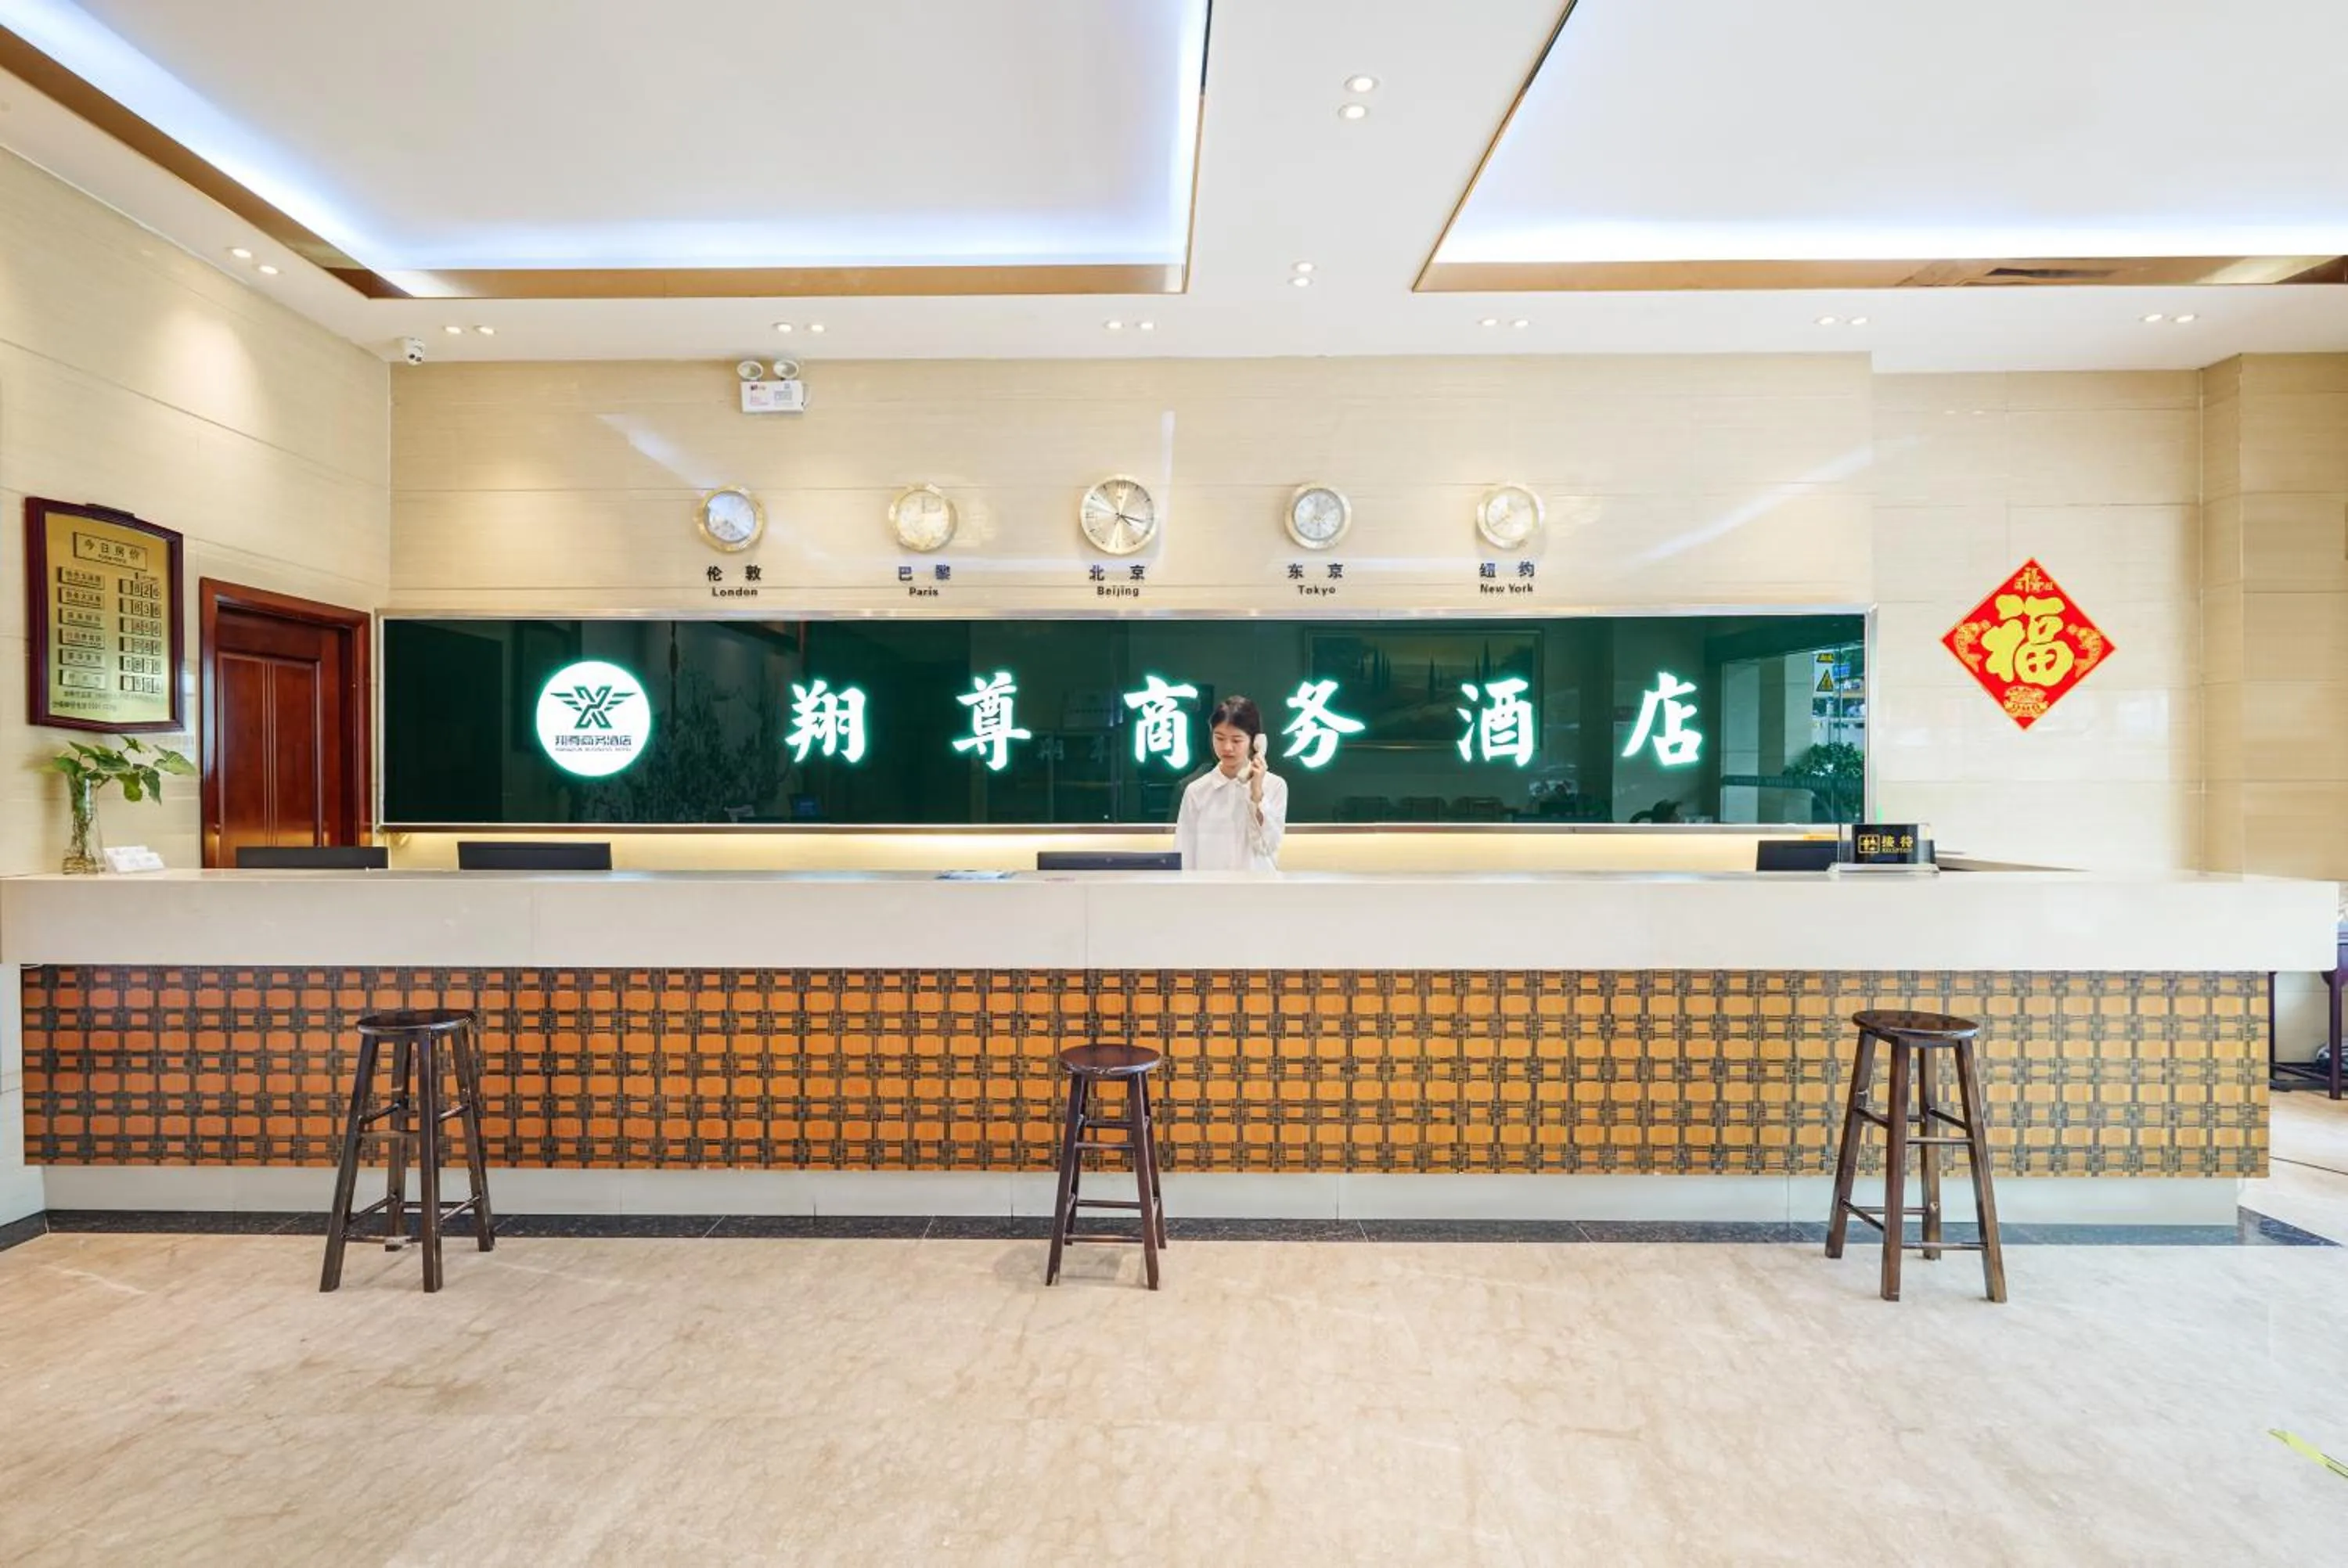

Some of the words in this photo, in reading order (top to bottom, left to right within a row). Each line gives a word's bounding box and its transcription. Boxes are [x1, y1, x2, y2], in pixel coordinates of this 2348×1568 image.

[706, 564, 762, 582] 伦敦
[899, 564, 951, 581] 巴黎
[1089, 564, 1145, 581] 北京
[1288, 563, 1344, 580] 东京
[1479, 561, 1535, 578] 纽约
[711, 587, 758, 597] London
[909, 586, 938, 597] Paris
[1097, 585, 1140, 597] Beijing
[1298, 584, 1336, 596] Tokyo
[1480, 584, 1505, 594] New
[1508, 583, 1533, 594] York
[1980, 593, 2076, 687] 福
[785, 671, 1703, 771] 翔尊商务酒店
